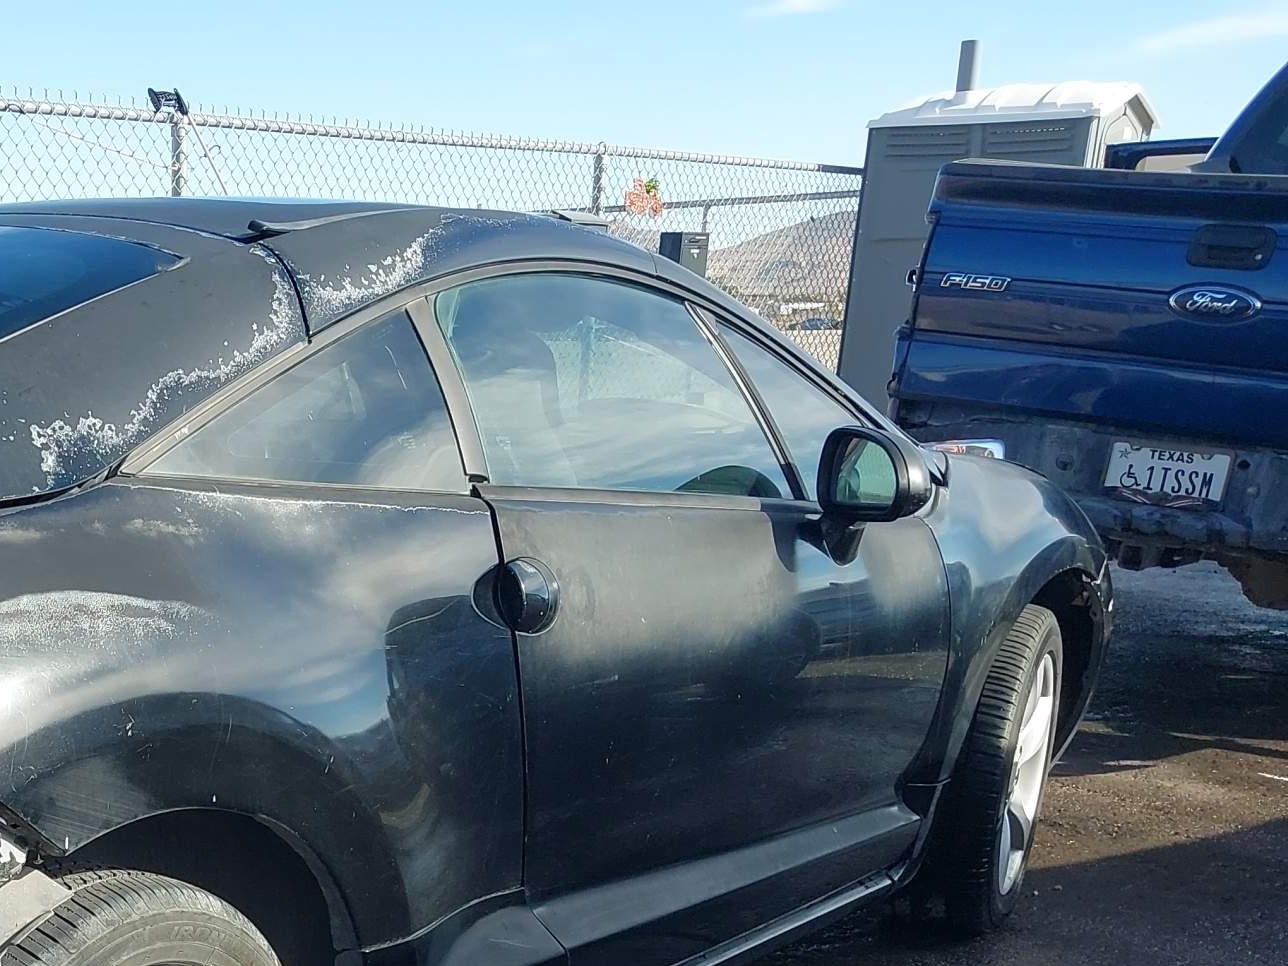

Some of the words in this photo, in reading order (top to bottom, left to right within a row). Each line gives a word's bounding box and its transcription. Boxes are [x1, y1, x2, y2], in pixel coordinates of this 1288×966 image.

[940, 272, 1011, 292] F-150
[1186, 291, 1238, 314] Ford
[1150, 449, 1195, 464] TEXAS
[1142, 465, 1215, 498] 1TSSM
